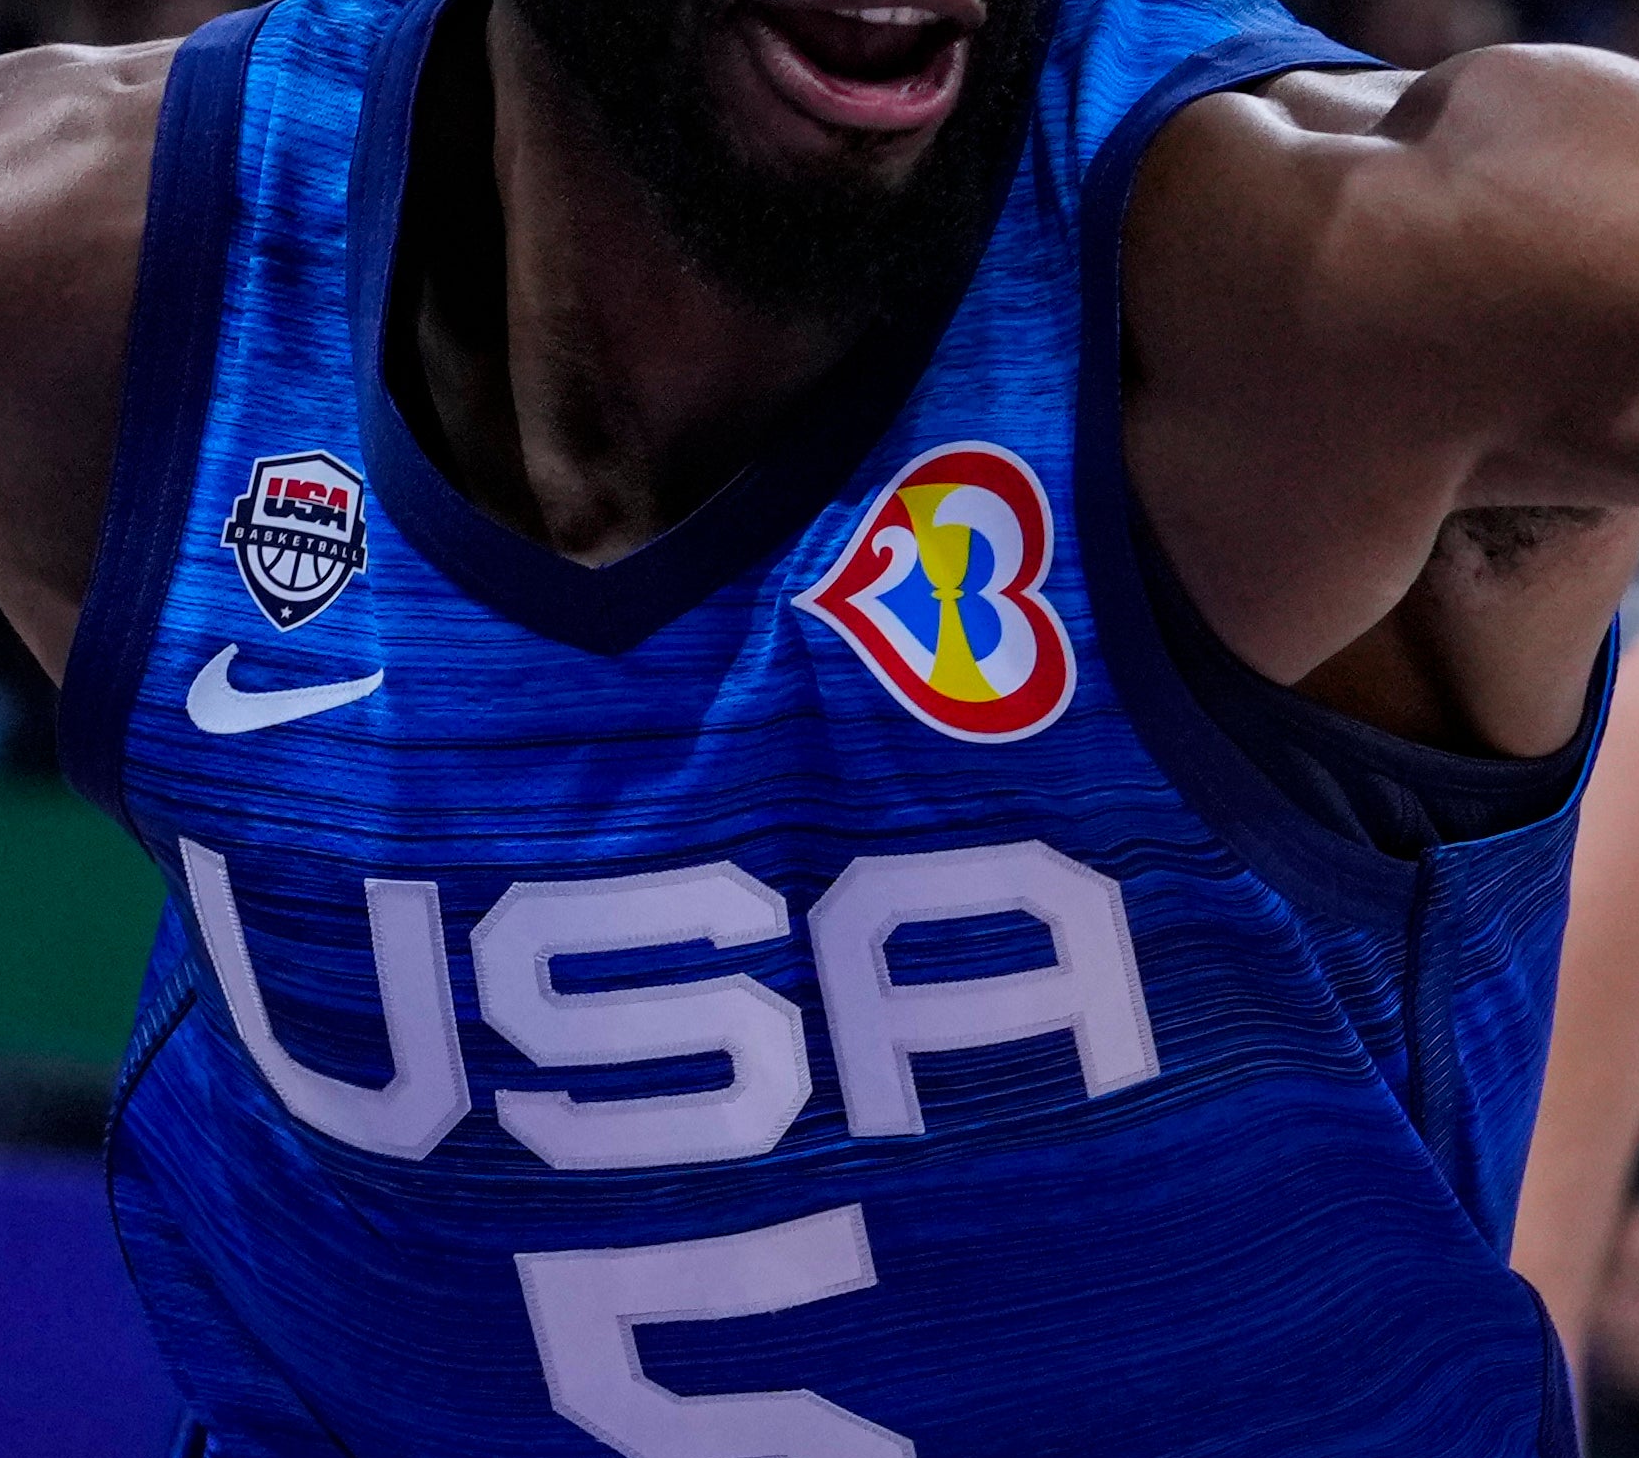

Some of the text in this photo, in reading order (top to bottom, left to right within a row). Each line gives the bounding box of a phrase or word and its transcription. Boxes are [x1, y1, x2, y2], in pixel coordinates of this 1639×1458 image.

[263, 477, 350, 532] USA
[234, 526, 359, 562] BASKETBALL
[179, 836, 1159, 1171] USA
